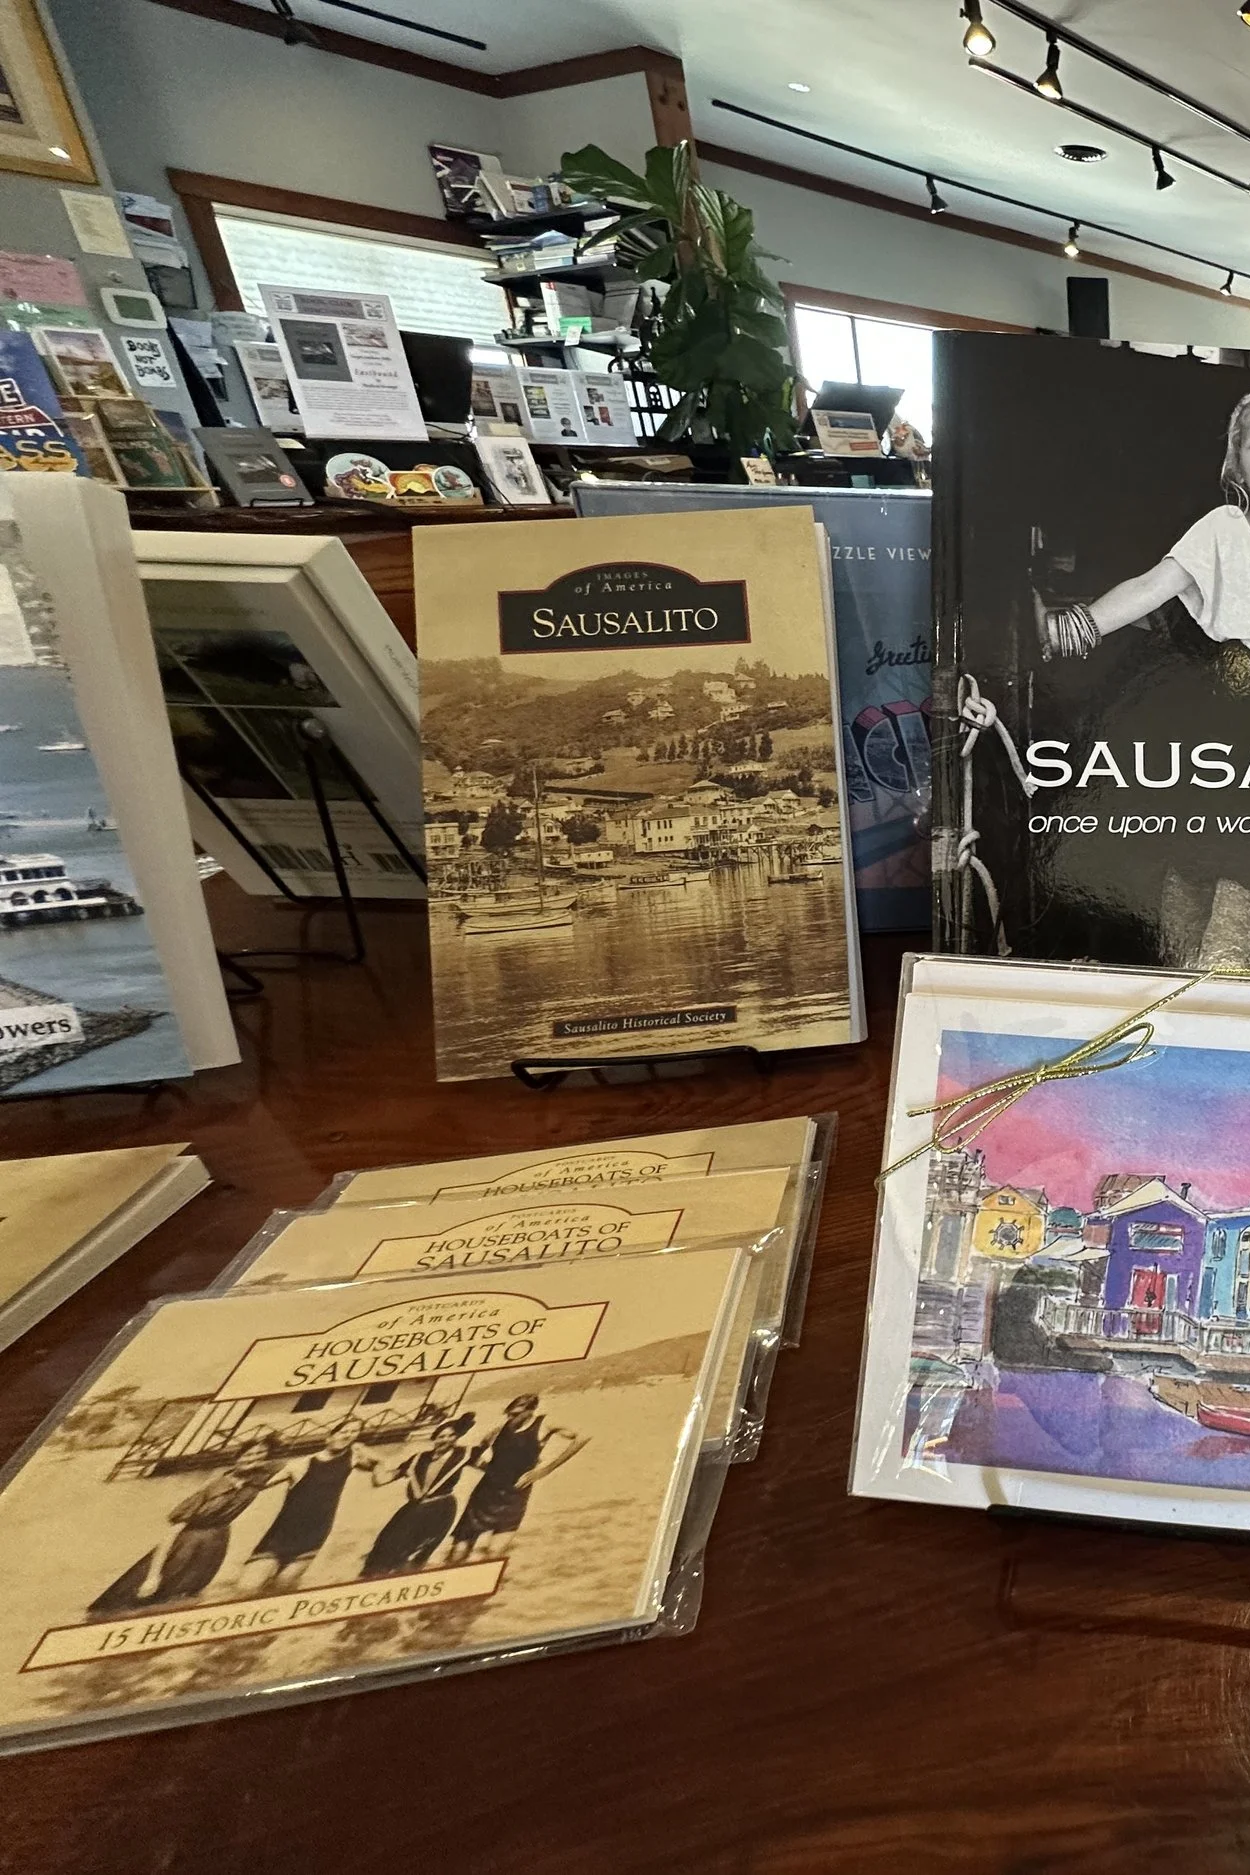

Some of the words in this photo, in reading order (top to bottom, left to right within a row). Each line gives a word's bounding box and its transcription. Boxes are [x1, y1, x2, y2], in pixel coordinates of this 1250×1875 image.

[597, 571, 649, 581] IMAGES
[575, 583, 591, 596] of
[602, 581, 673, 593] America
[1028, 814, 1098, 834] once
[1108, 814, 1177, 838] upon
[1186, 814, 1205, 834] a
[563, 1020, 618, 1035] Sausalito
[622, 1014, 681, 1030] Historical
[685, 1011, 727, 1024] Society
[562, 1160, 630, 1174] America
[482, 1170, 632, 1198] HOUSEBOATS
[639, 1163, 669, 1176] OF
[485, 1221, 508, 1232] of
[513, 1214, 590, 1228] America
[426, 1224, 593, 1253] HOUSEBOATS
[598, 1220, 632, 1235] OF
[413, 1236, 623, 1272] SAUSALITO
[377, 1318, 403, 1330] of
[412, 1308, 501, 1326] America
[303, 1323, 502, 1361] HOUSEBOATS
[508, 1317, 548, 1337] OF
[284, 1338, 536, 1388] SAUSALITO
[99, 1629, 132, 1651] 15
[138, 1609, 280, 1645] HISTORIC
[288, 1581, 446, 1620] POSTCARDS
